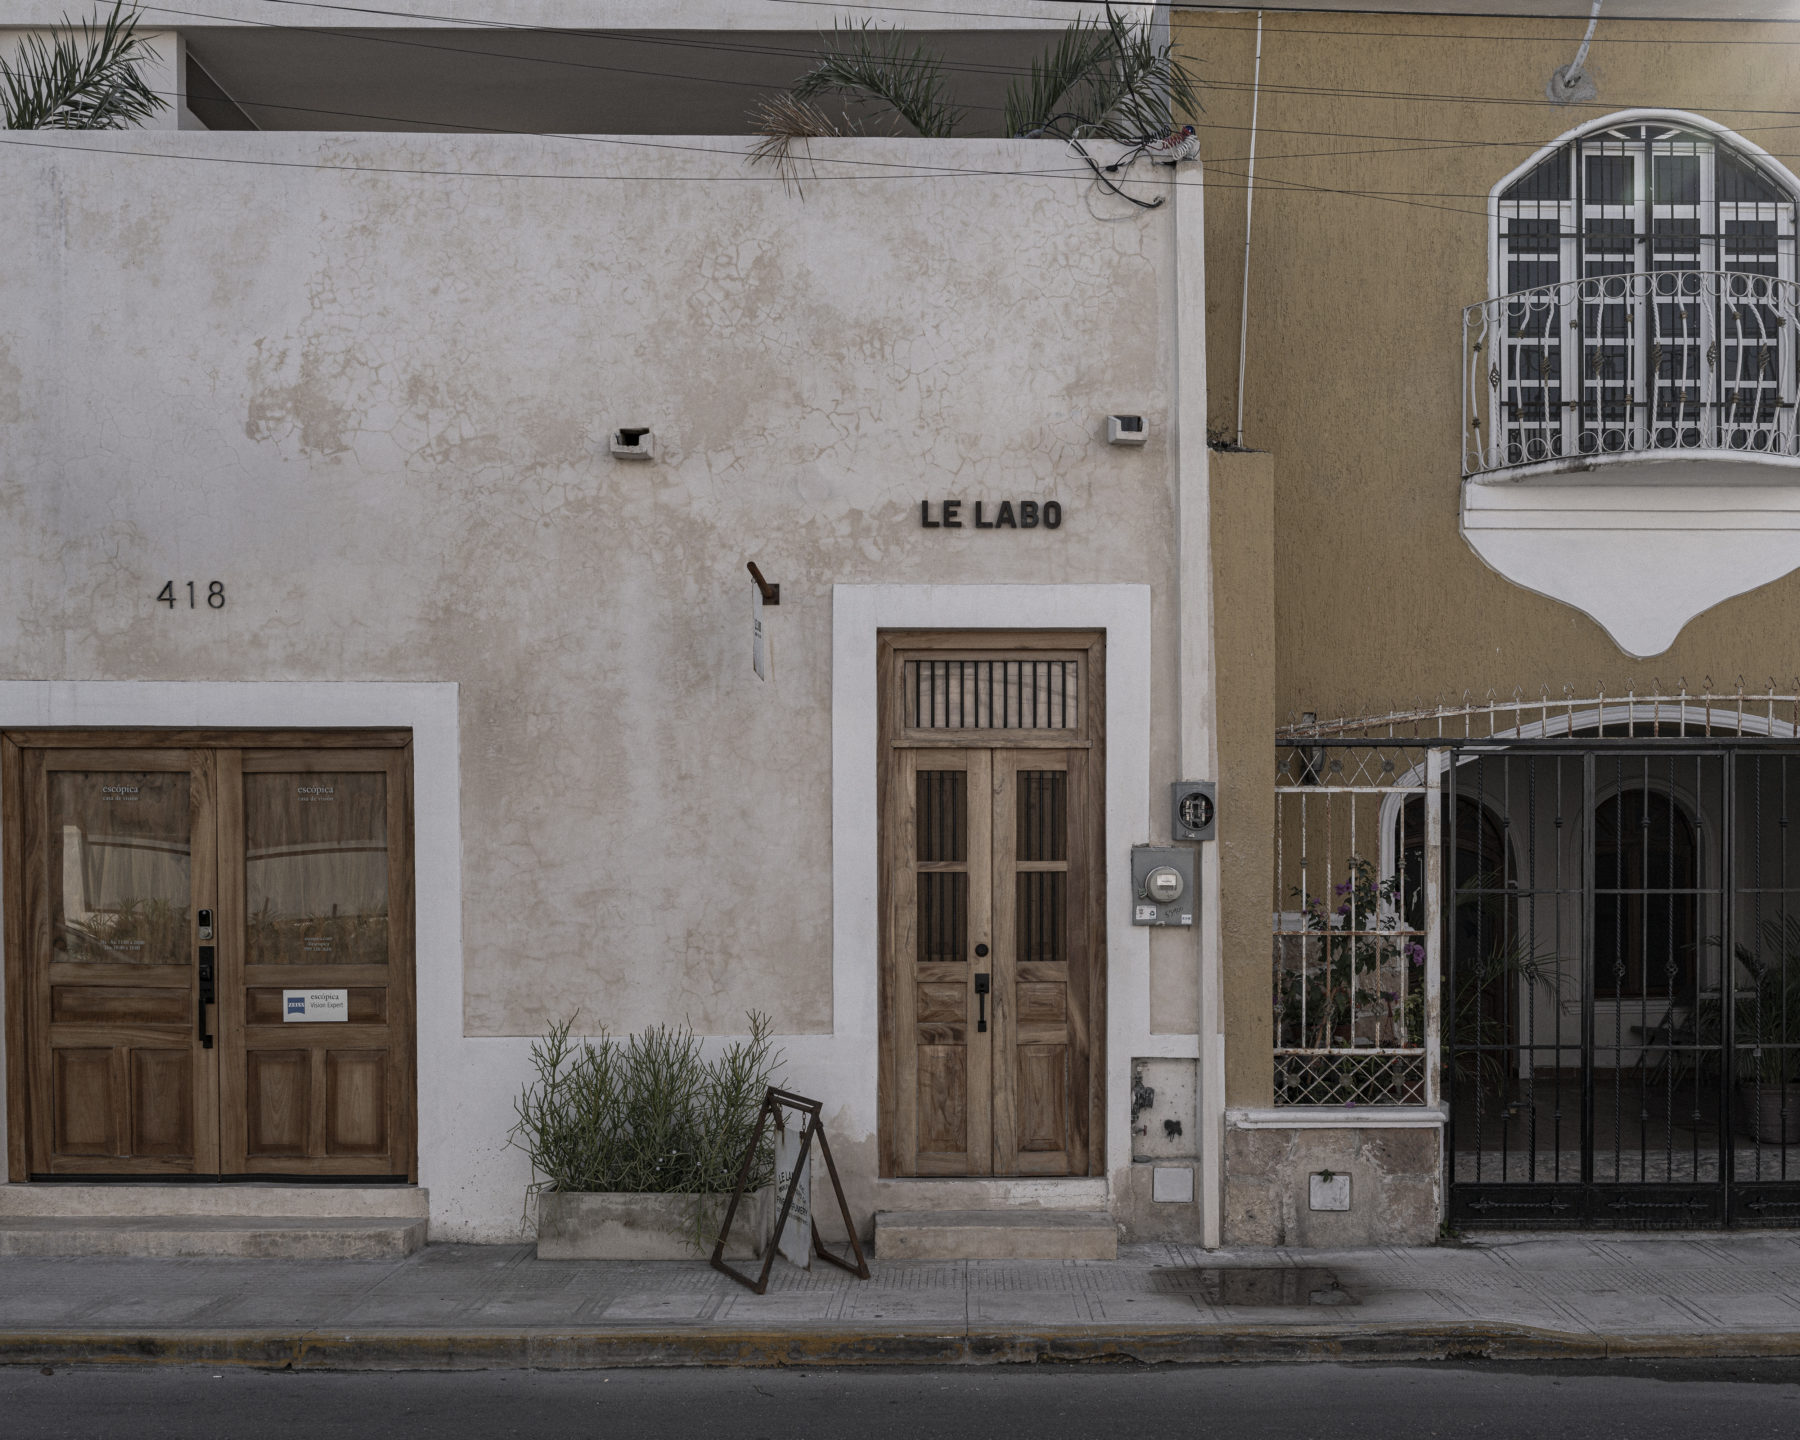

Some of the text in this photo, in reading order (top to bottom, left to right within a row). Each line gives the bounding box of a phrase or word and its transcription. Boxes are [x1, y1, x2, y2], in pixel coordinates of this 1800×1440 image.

[921, 499, 1062, 529] LE LABO
[156, 580, 225, 609] 418
[102, 784, 139, 795] escópica
[297, 784, 334, 795] escópica
[310, 993, 339, 1001] escópica
